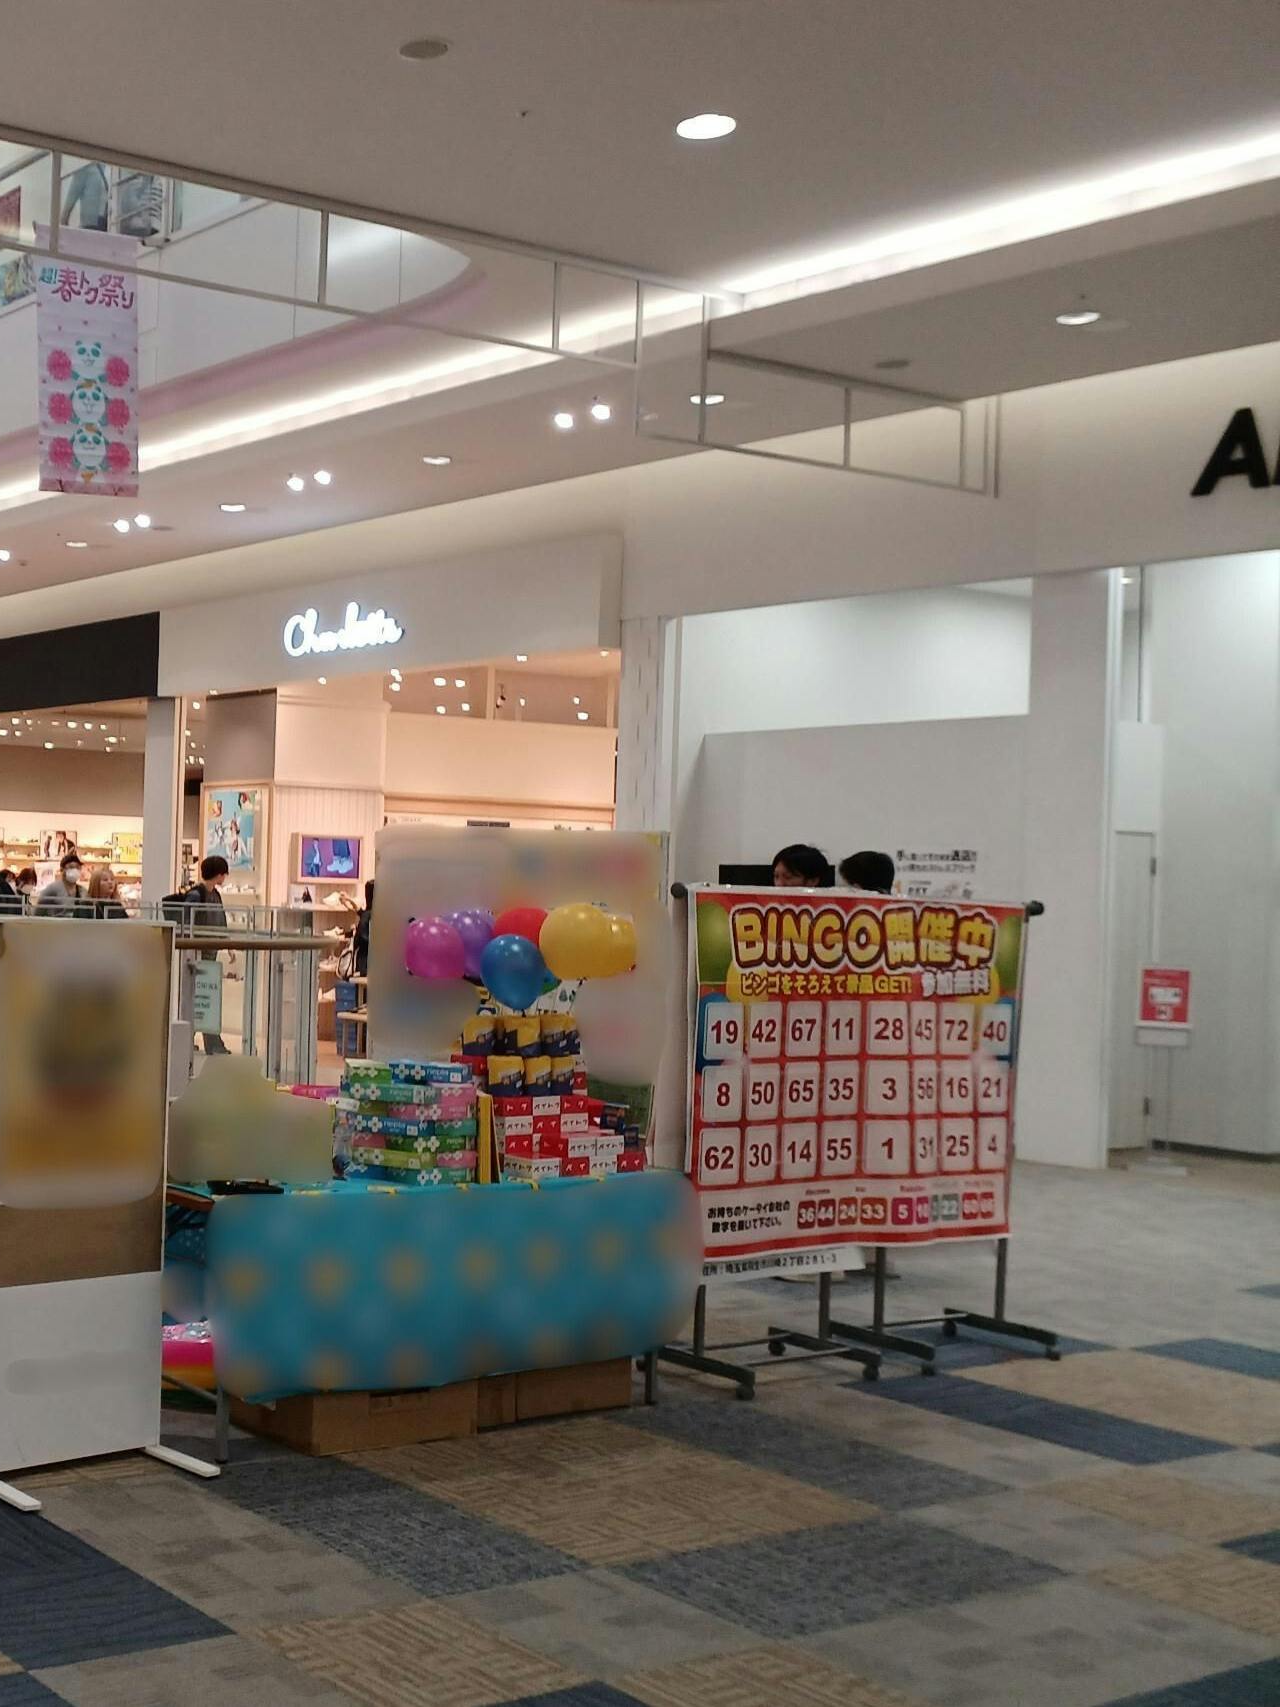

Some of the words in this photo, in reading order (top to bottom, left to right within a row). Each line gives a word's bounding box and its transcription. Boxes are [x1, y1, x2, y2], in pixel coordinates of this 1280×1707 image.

[1190, 406, 1280, 498] A
[733, 908, 995, 969] BINGO開催中
[711, 1020, 738, 1044] 19
[752, 1019, 776, 1042] 42
[791, 1018, 817, 1041] 67
[832, 1018, 854, 1040] 11
[874, 1018, 903, 1040] 28
[915, 1019, 932, 1040] 45
[944, 1020, 968, 1041] 72
[983, 1021, 1006, 1042] 40
[716, 1083, 730, 1106] 8
[751, 1081, 774, 1105] 50
[788, 1079, 814, 1103] 65
[828, 1078, 853, 1101] 35
[882, 1078, 896, 1100] 3
[946, 1077, 968, 1098] 16
[982, 1077, 1001, 1098] 21
[704, 1146, 735, 1170] 62
[749, 1143, 772, 1166] 30
[787, 1140, 811, 1163] 14
[827, 1138, 851, 1160] 55
[881, 1138, 893, 1159] 1
[946, 1136, 969, 1156] 25
[987, 1135, 998, 1154] 4
[798, 1207, 815, 1223] 36
[817, 1205, 834, 1221] 44
[862, 1203, 885, 1219] 33
[898, 1204, 908, 1219] 5
